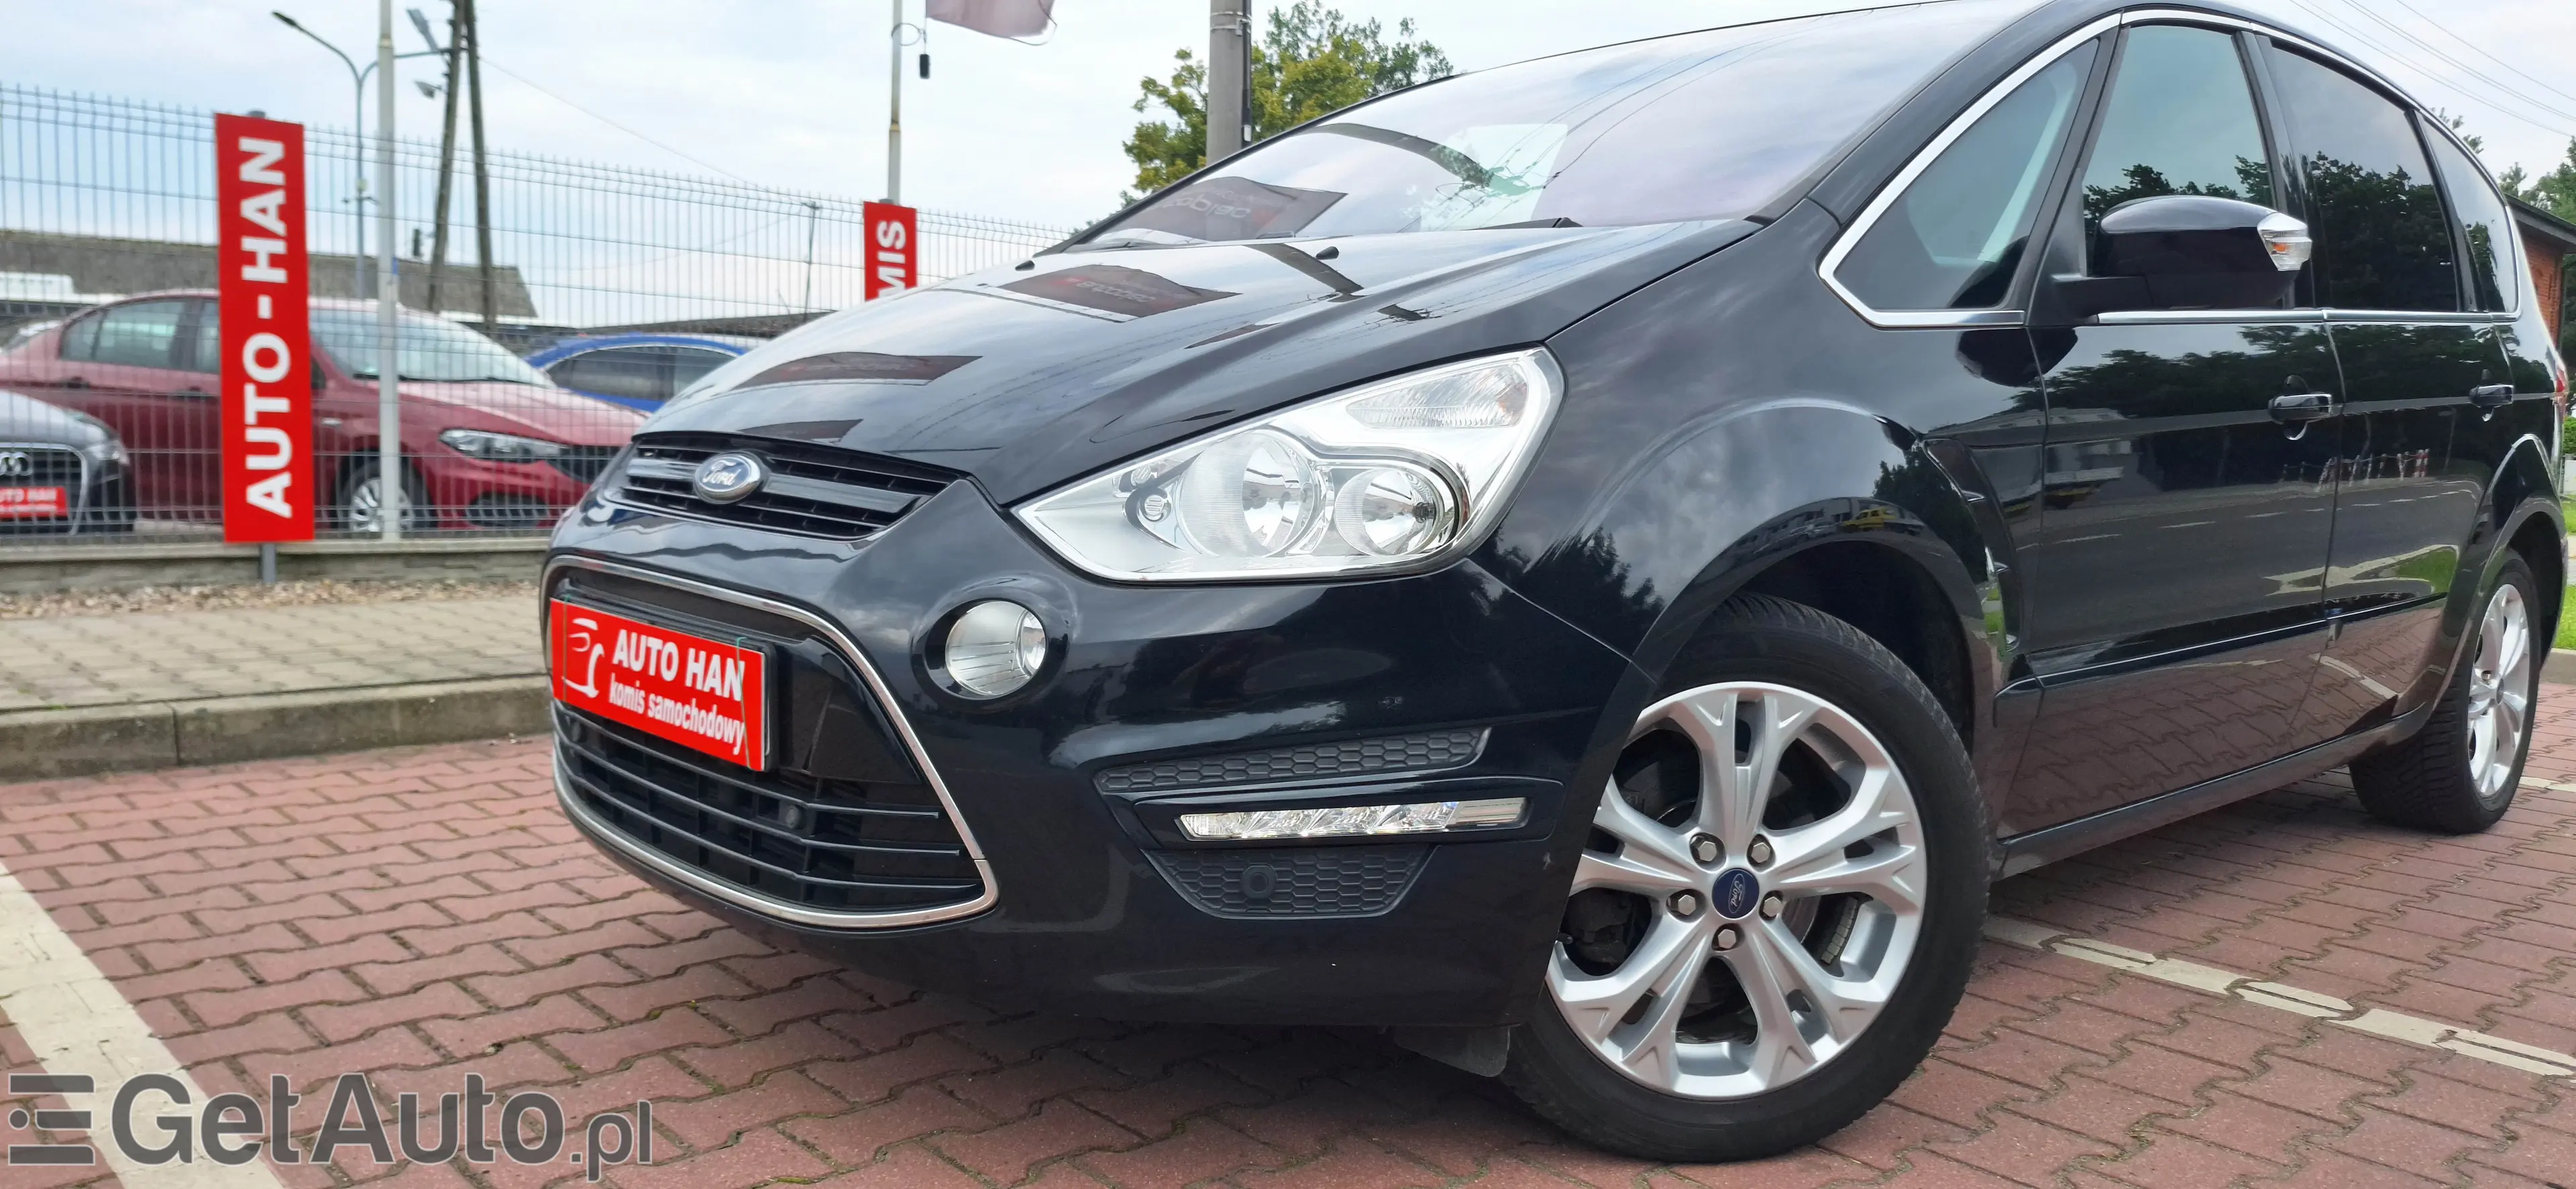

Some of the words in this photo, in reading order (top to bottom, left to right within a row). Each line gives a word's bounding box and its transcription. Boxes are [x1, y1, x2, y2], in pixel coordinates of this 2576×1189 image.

[239, 137, 287, 284] HAN
[243, 333, 292, 518] AUTO
[702, 460, 741, 486] Ford
[612, 629, 679, 681] AUTO
[685, 648, 745, 701] HAN
[608, 672, 645, 715] komis
[647, 693, 745, 756] samochodowy
[1731, 881, 1743, 907] Ford
